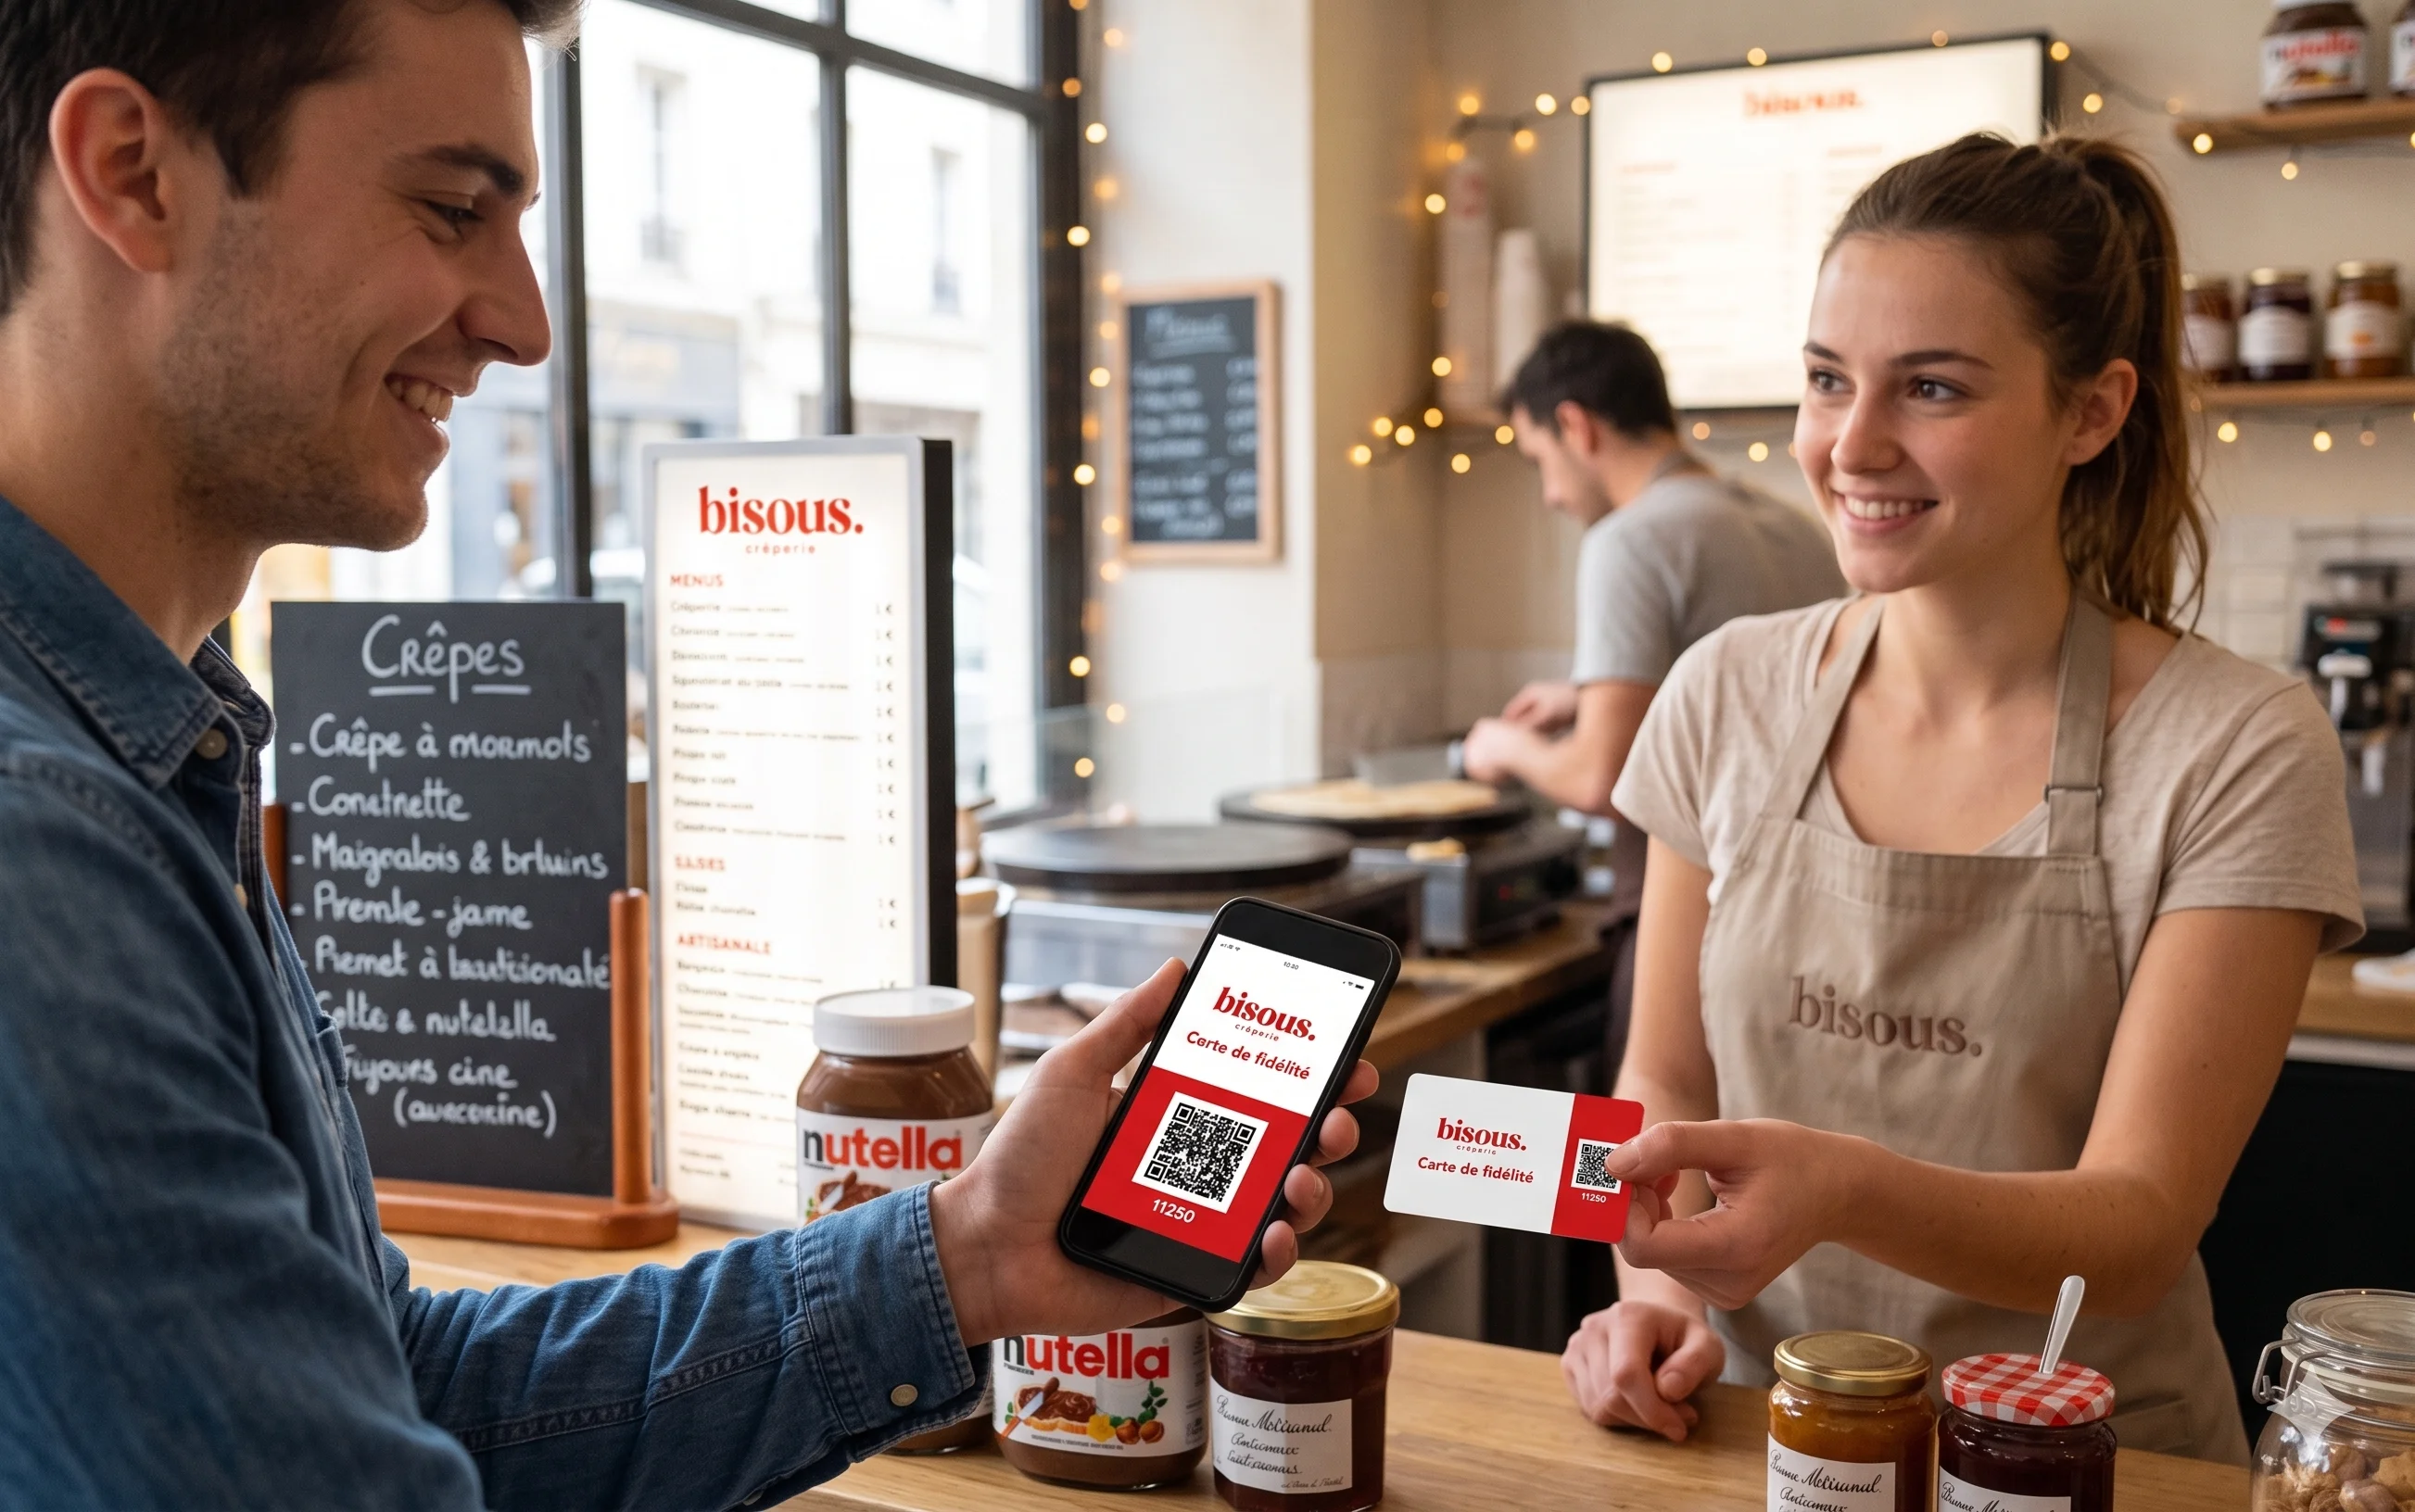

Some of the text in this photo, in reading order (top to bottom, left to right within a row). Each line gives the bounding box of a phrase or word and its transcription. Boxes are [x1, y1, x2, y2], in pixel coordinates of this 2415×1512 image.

[698, 485, 864, 535] bisous.
[361, 614, 525, 704] Crêpes
[416, 722, 439, 758] à
[470, 839, 492, 875] &
[419, 947, 442, 980] à
[1213, 987, 1316, 1041] bisous.
[1788, 976, 1982, 1057] bisous.
[1186, 1030, 1310, 1080] Carte de fidélité
[803, 1126, 963, 1171] nutella
[1436, 1117, 1526, 1151] bisous.
[1418, 1156, 1534, 1184] Carte de fidélité
[1152, 1199, 1195, 1224] 11250
[1581, 1192, 1607, 1203] 11250
[1004, 1332, 1170, 1380] nutella
